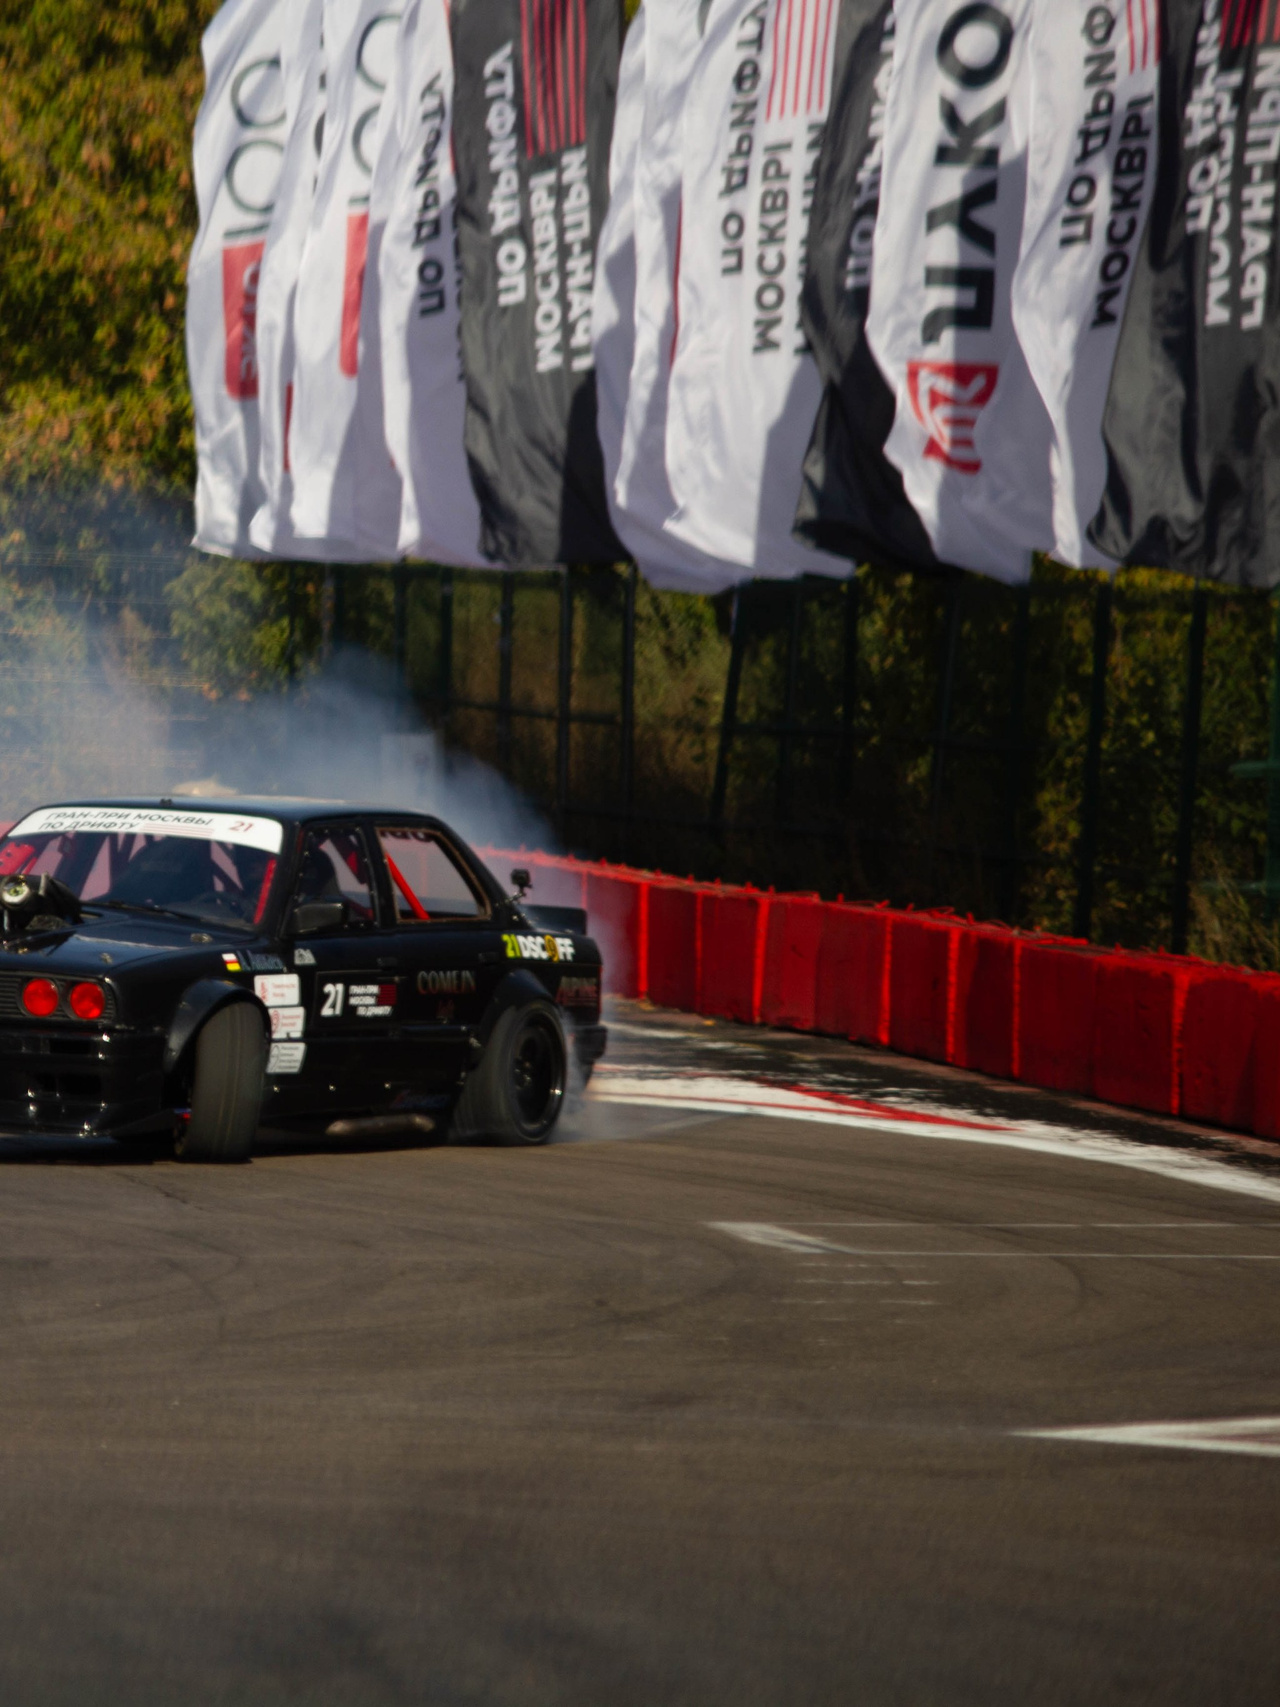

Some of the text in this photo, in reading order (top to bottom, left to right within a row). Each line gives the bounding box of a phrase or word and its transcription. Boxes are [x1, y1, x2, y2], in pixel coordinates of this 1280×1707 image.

[38, 820, 141, 831] ПО ДРИФТУ
[46, 811, 214, 826] ГРАН-ПРИ МОСКВЫ
[229, 820, 254, 833] 21
[320, 982, 345, 1017] 21
